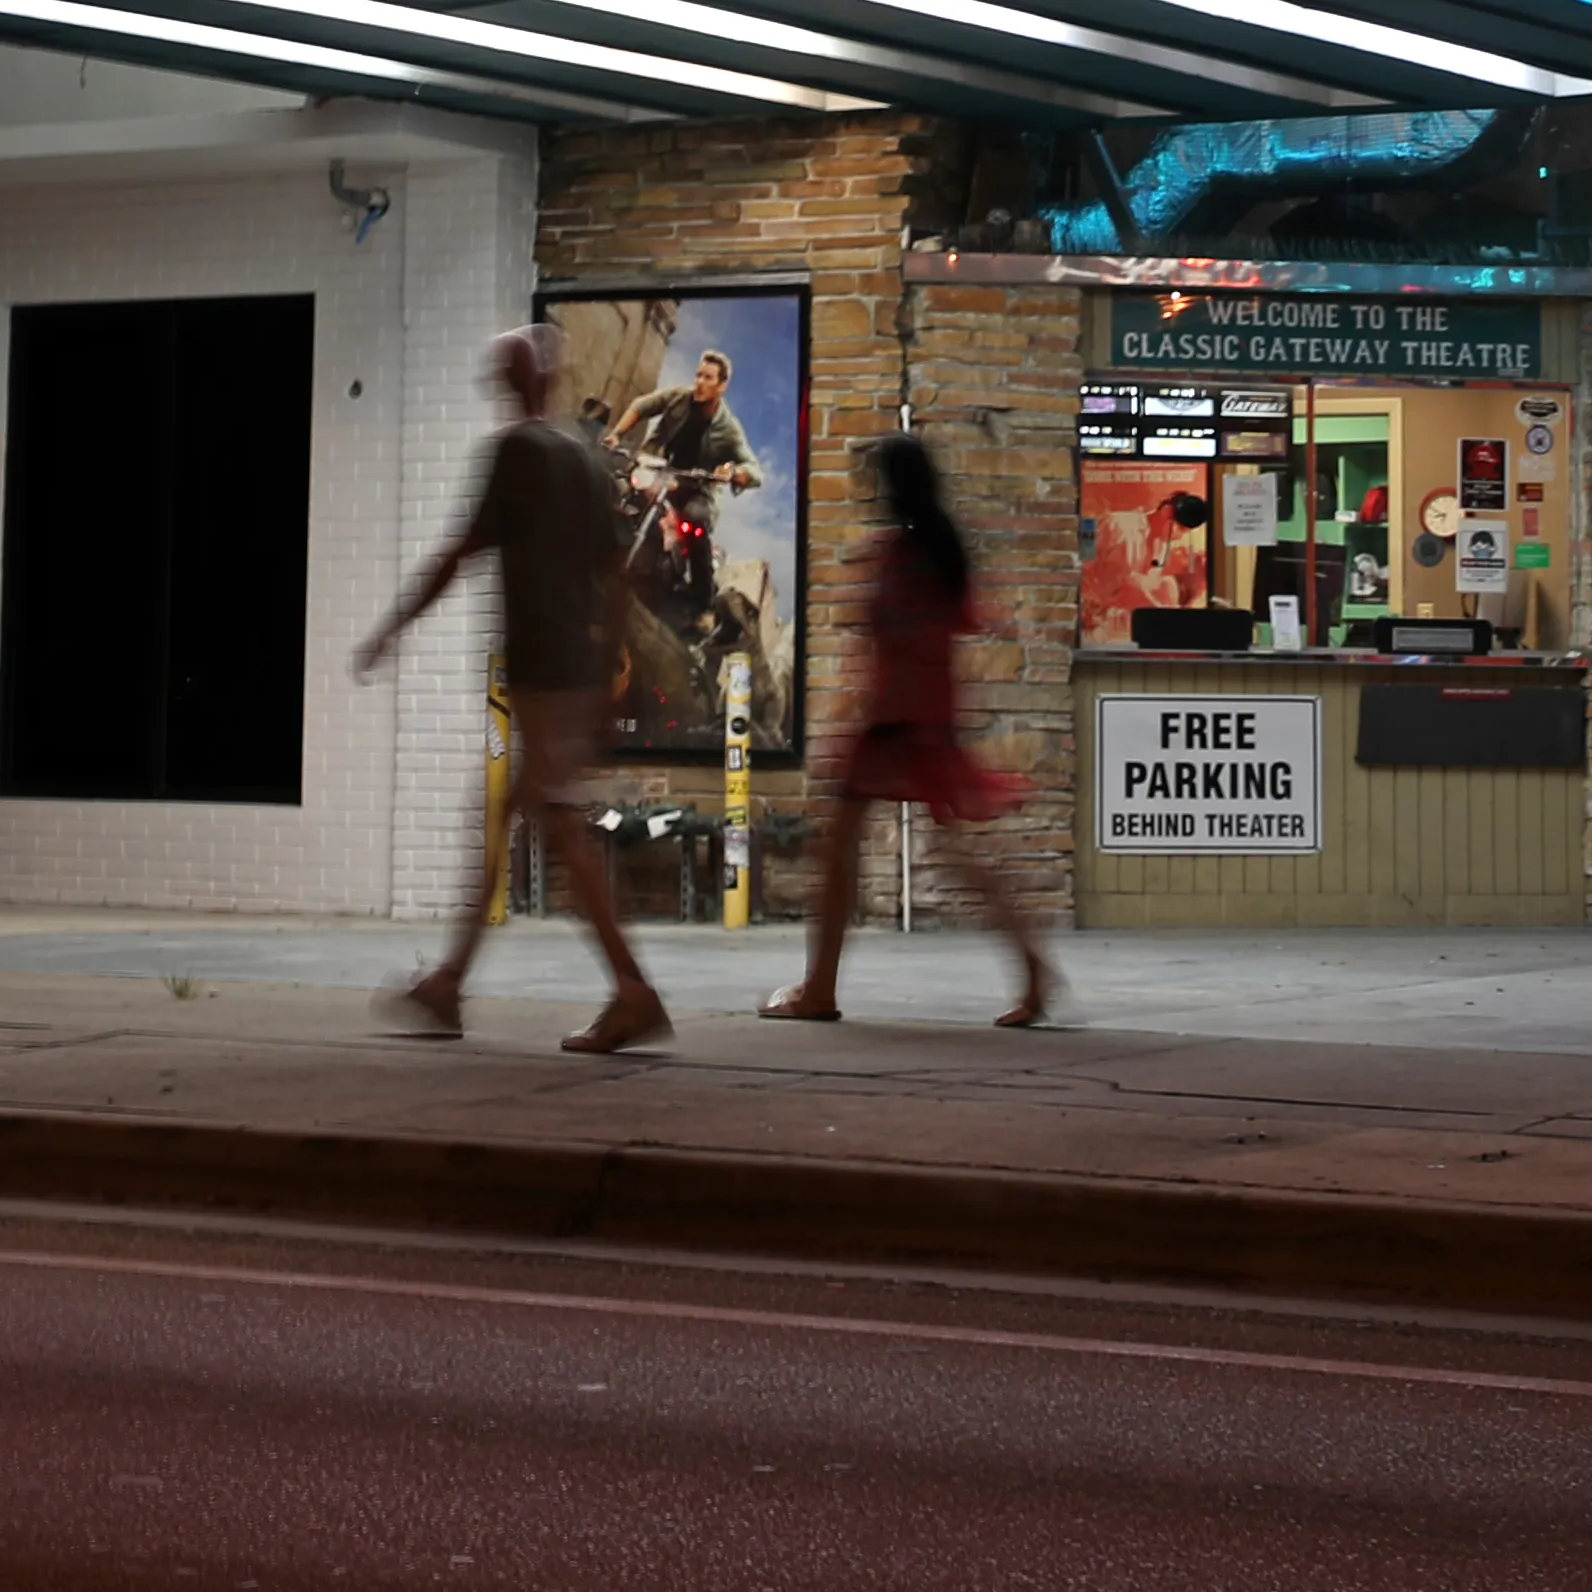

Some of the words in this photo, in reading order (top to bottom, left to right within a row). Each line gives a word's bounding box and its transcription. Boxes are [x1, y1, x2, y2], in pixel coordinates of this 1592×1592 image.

[1208, 300, 1340, 327] WELCOME
[1351, 305, 1385, 329] TO
[1396, 307, 1449, 332] THE
[1123, 331, 1239, 360] CLASSIC
[1250, 336, 1390, 364] GATEWAY
[1401, 341, 1530, 369] THEATRE
[1161, 712, 1256, 750] FREE
[1124, 761, 1292, 800] PARKING
[1112, 813, 1195, 838] BEHIND
[1205, 814, 1305, 838] THEATER
